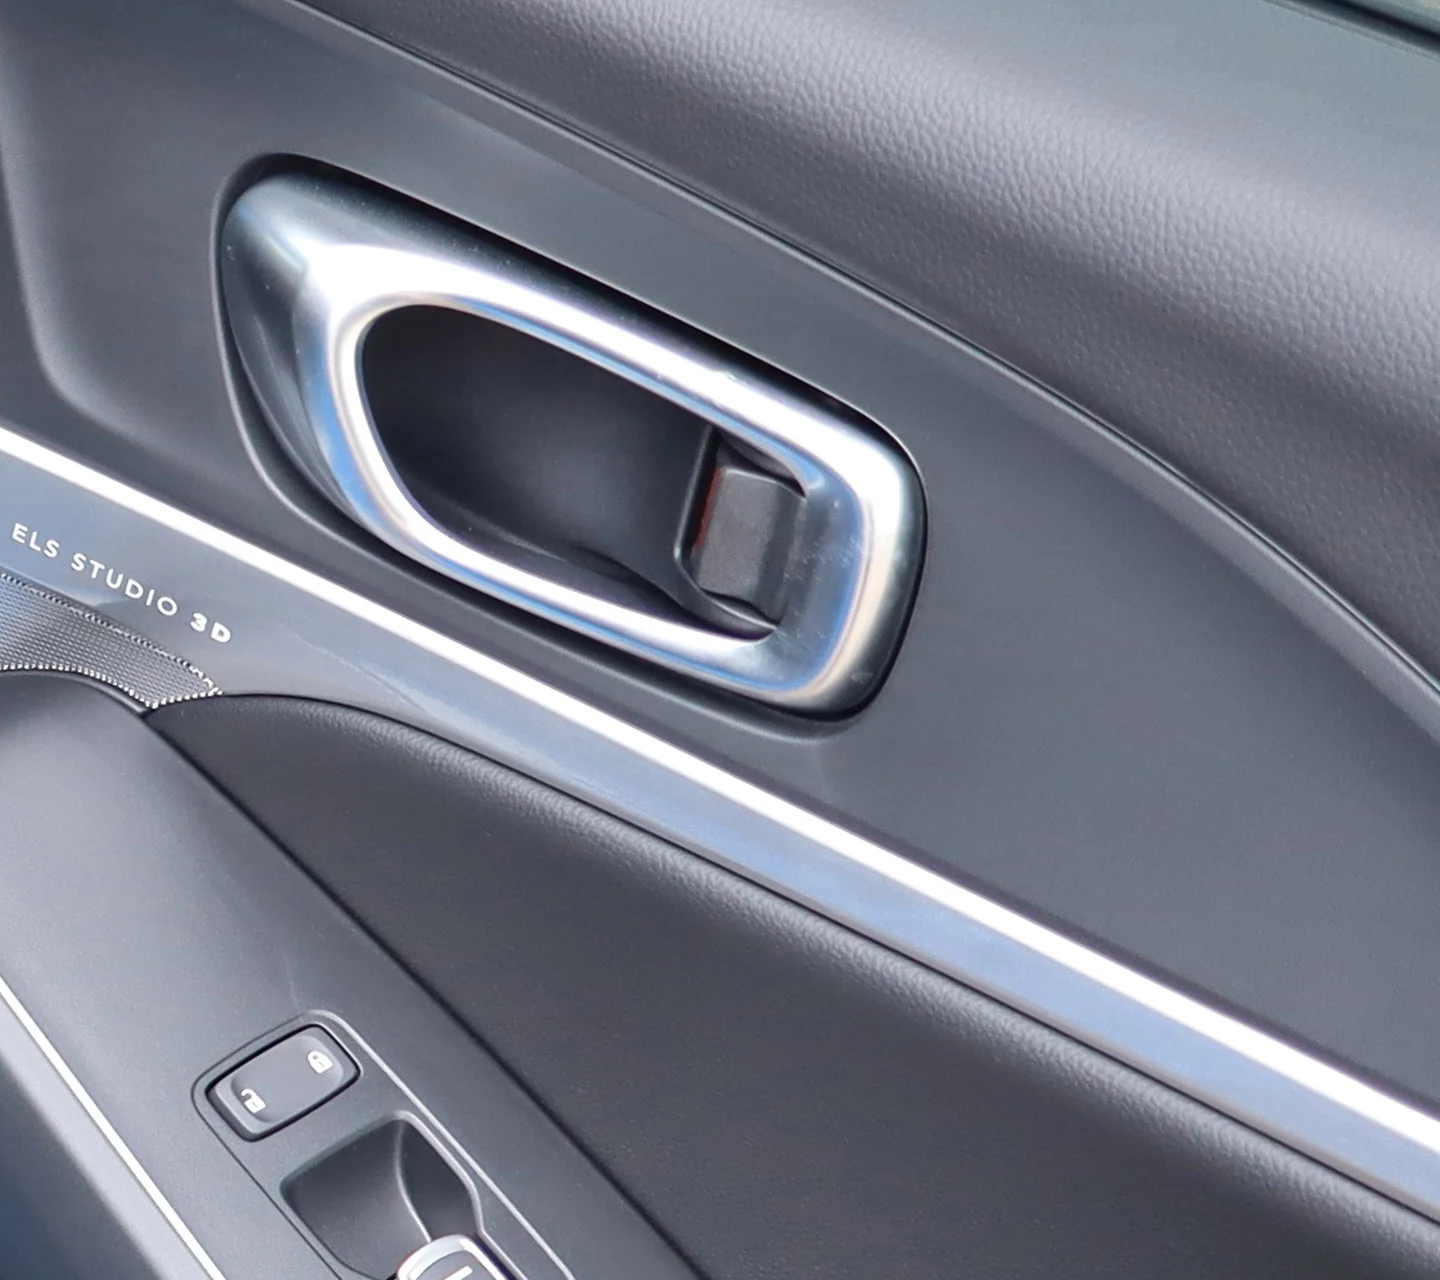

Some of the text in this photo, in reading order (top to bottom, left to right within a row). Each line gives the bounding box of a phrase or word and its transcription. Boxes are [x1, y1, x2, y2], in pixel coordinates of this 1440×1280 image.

[11, 522, 231, 644] ELS STUDIO 3D
